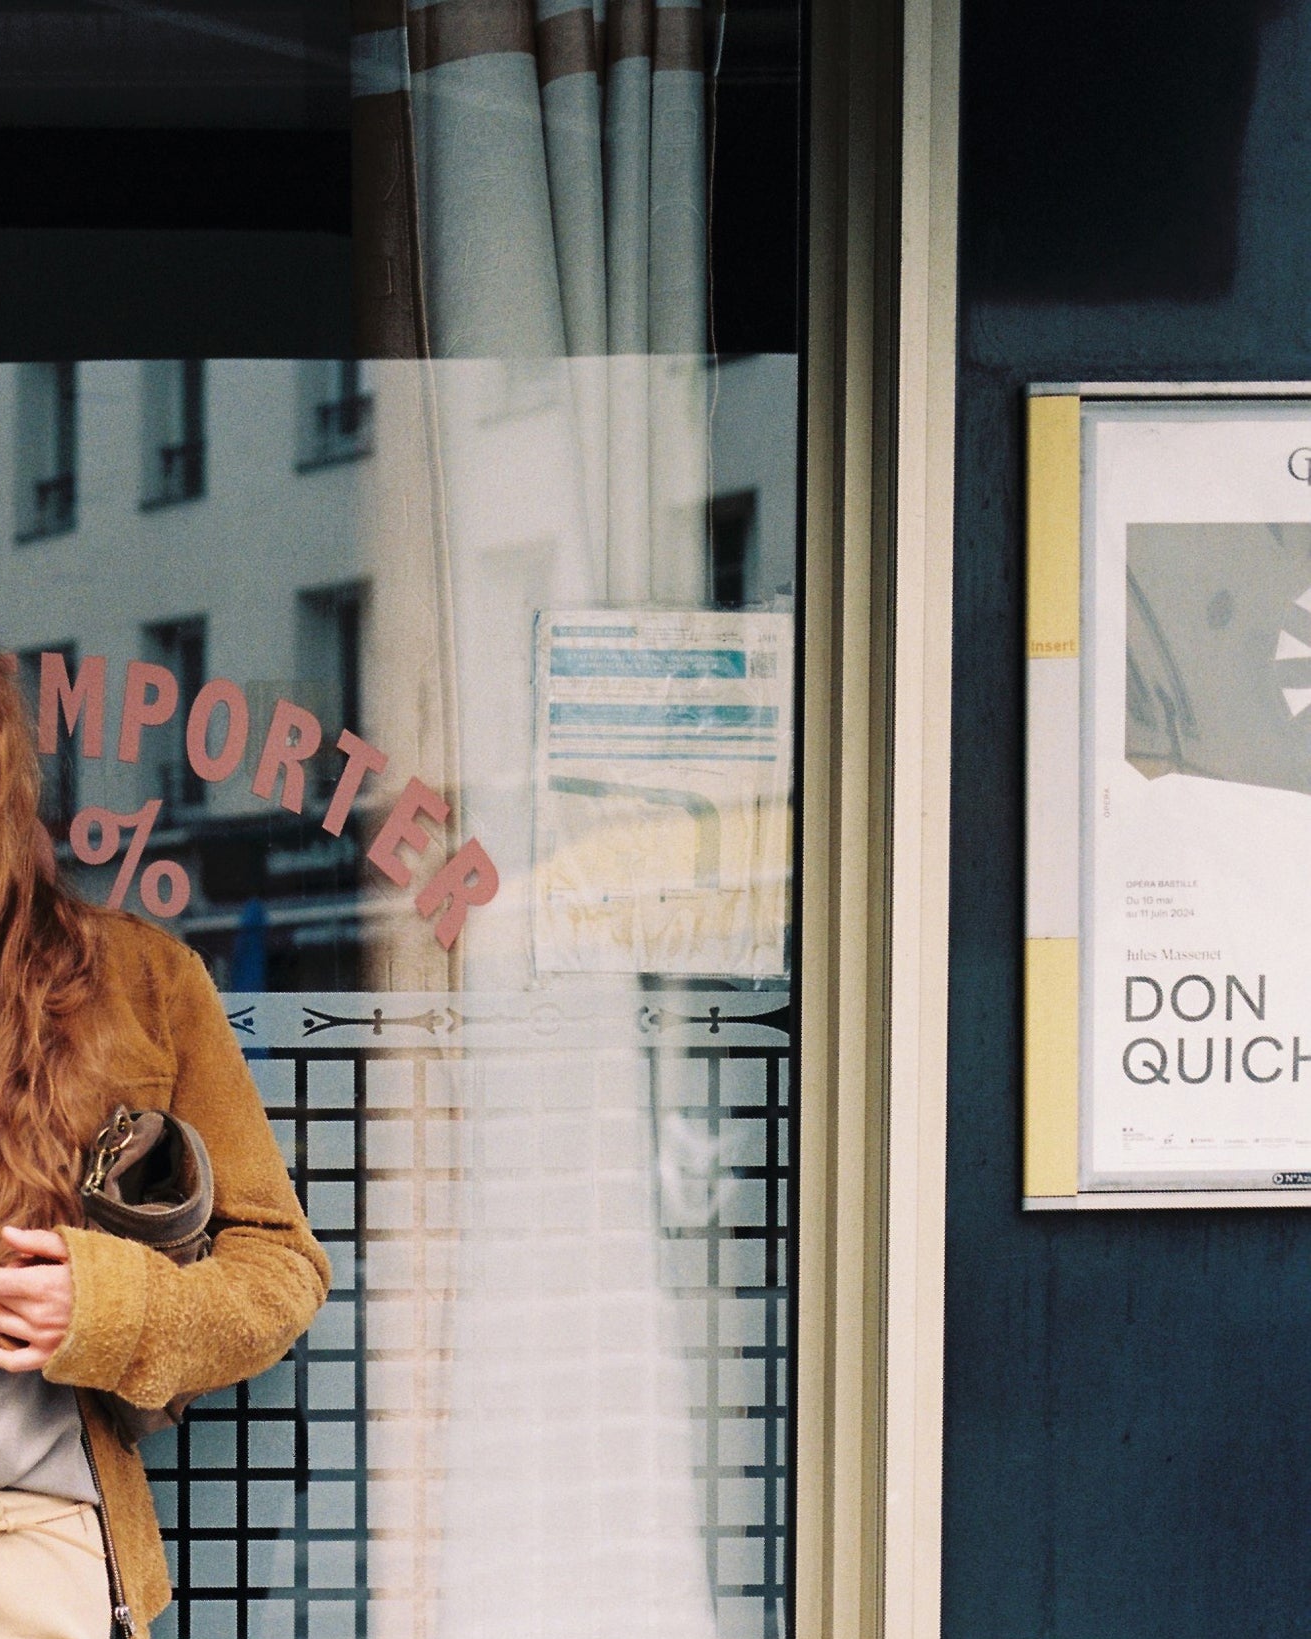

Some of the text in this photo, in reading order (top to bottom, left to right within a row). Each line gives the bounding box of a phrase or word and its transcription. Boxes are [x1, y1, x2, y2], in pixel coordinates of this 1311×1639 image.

[1, 652, 499, 951] MPORTER
[1157, 879, 1198, 889] BASTILLE
[1125, 896, 1139, 905] Du
[1170, 908, 1195, 918] 2024
[1126, 948, 1222, 962] Jules Massenet
[1124, 973, 1267, 1023] DON
